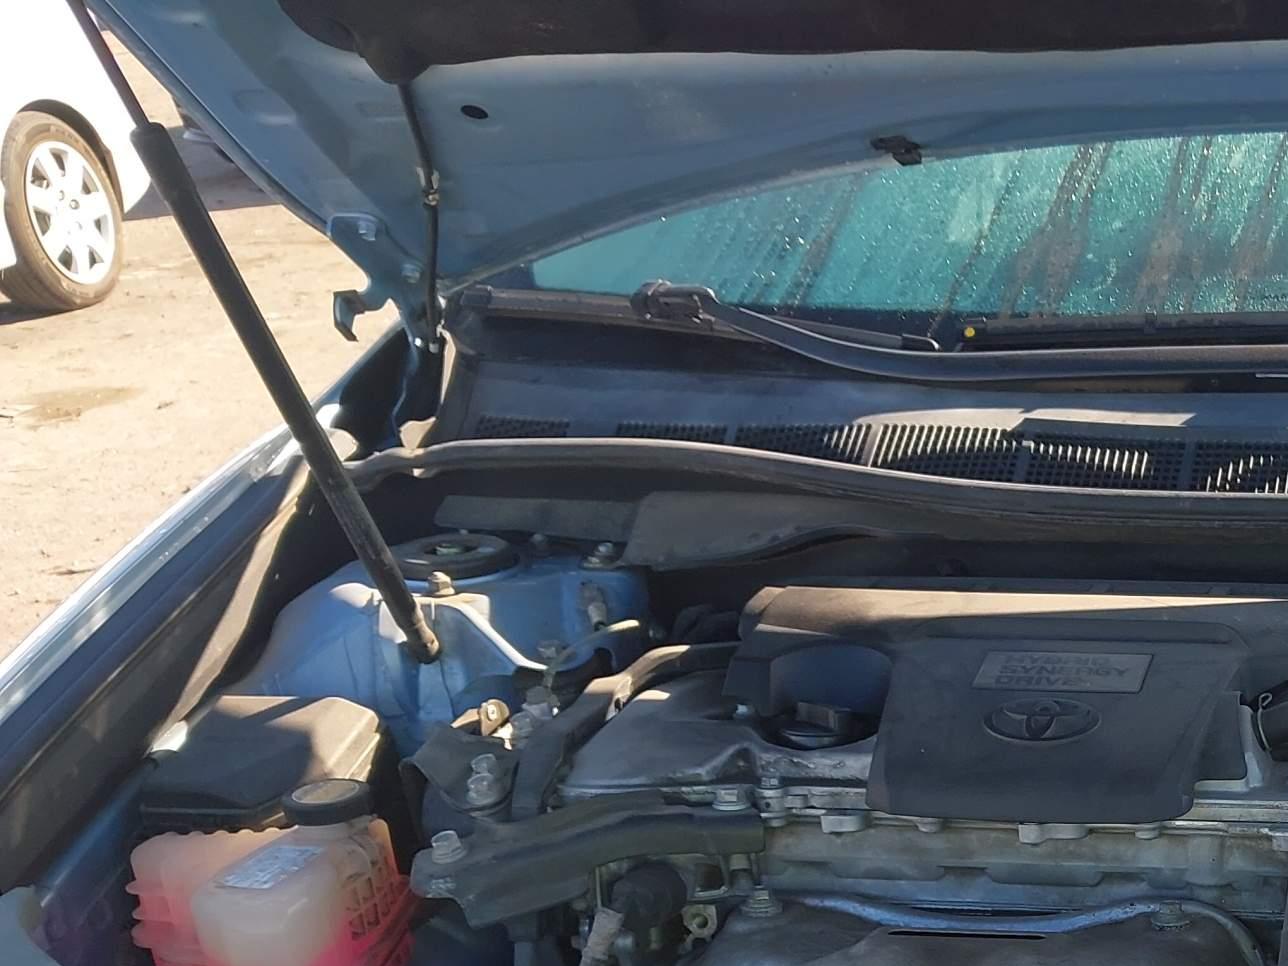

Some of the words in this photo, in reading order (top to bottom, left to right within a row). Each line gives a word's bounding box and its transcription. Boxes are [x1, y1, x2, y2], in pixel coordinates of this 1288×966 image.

[1004, 654, 1111, 666] HYBRID
[999, 664, 1130, 677] SYNERGY
[993, 675, 1086, 688] DRIVE
